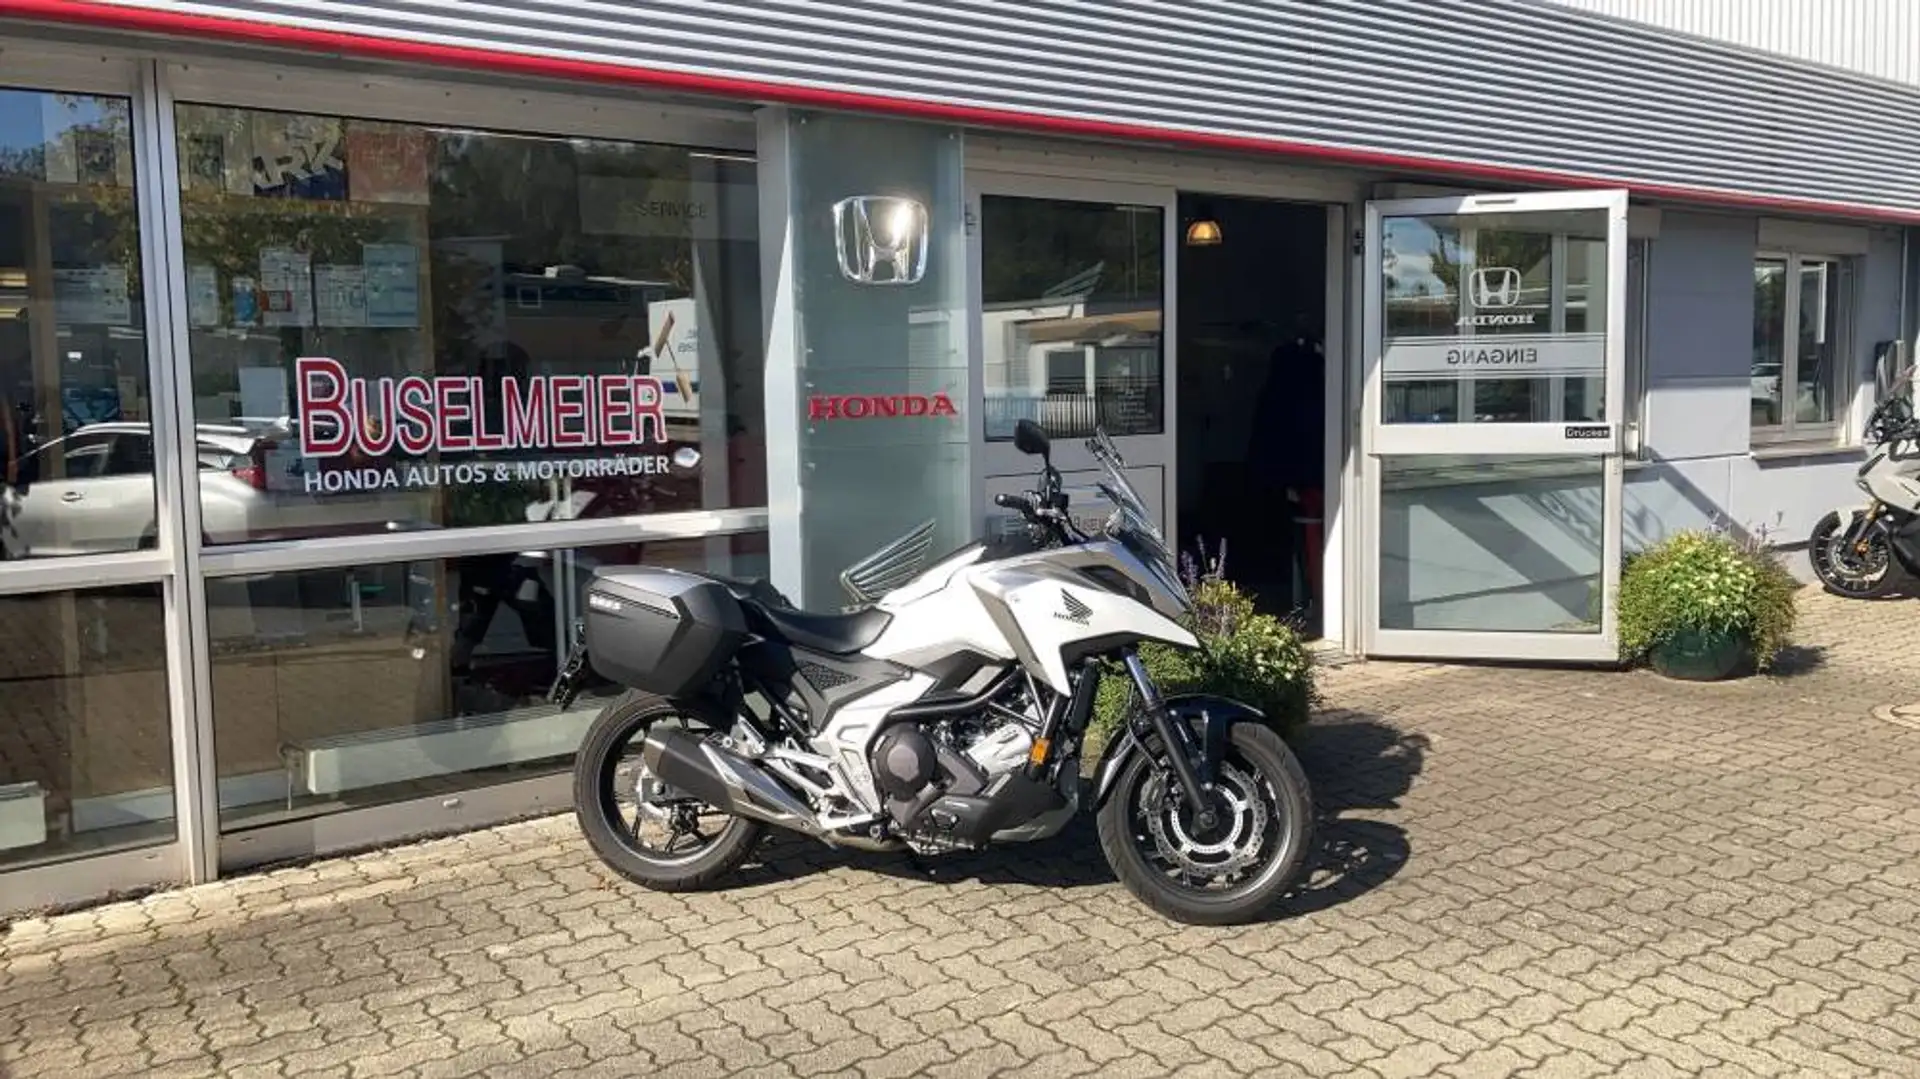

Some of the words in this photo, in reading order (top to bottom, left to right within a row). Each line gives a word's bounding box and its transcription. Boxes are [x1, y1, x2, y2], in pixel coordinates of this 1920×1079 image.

[296, 356, 668, 458] BUSELMEIER
[808, 393, 959, 420] HONDA
[304, 467, 400, 493] HONDA
[405, 463, 488, 488] AUTOS
[493, 461, 511, 483] &
[516, 453, 670, 481] MOTORRÄDER
